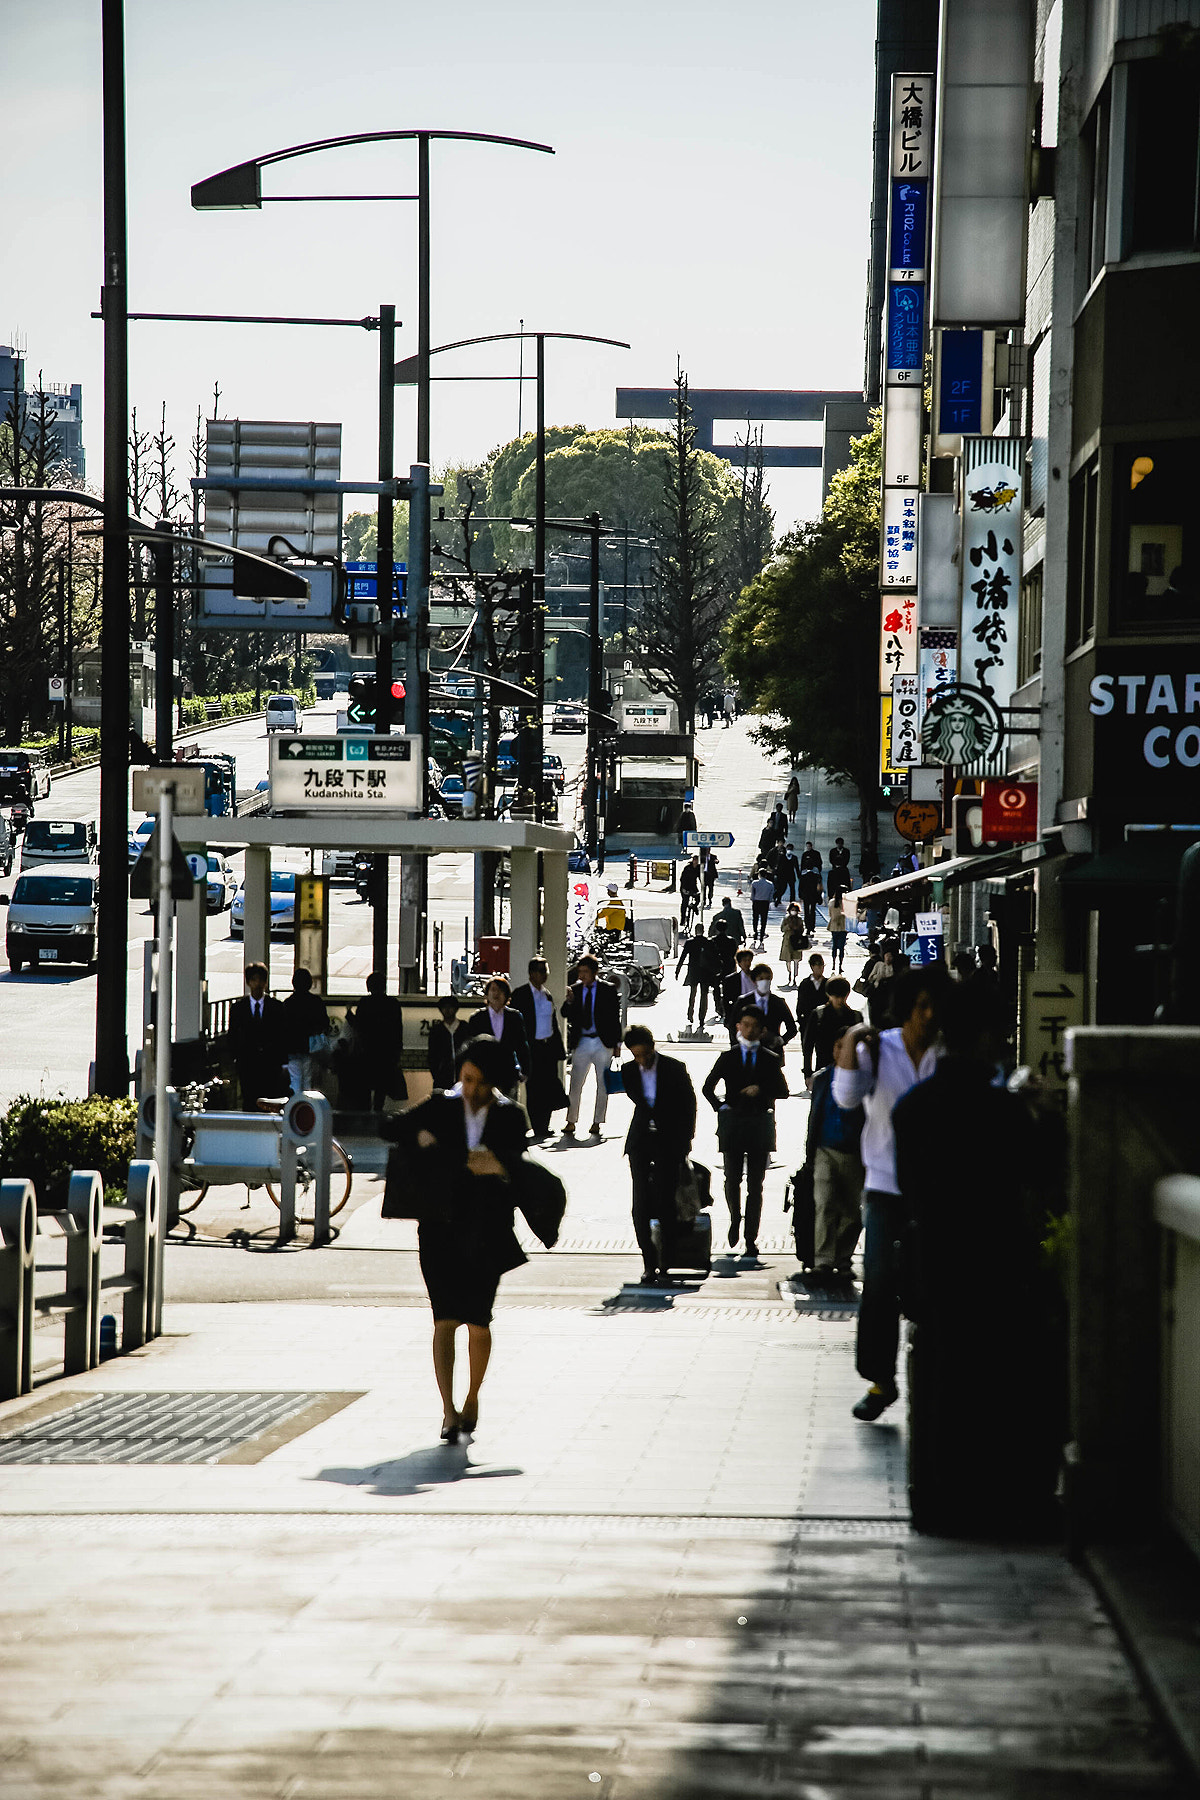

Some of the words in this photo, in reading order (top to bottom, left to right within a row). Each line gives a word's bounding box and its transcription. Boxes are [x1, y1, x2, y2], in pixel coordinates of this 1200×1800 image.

[900, 82, 923, 172] 大橋ビル
[904, 203, 915, 231] R102
[901, 271, 914, 279] 7F
[906, 312, 919, 366] 山本亜希
[898, 372, 911, 381] 6F
[951, 380, 971, 394] 2F
[952, 409, 970, 422] 1F
[896, 475, 909, 483] 5F
[1089, 674, 1200, 715] STAR
[896, 699, 917, 763] 日高屋
[1143, 725, 1200, 768] CO
[304, 768, 386, 788] 九段下駅
[890, 774, 906, 784] 1F
[304, 789, 364, 798] Kudanshita
[367, 789, 386, 798] Sta.
